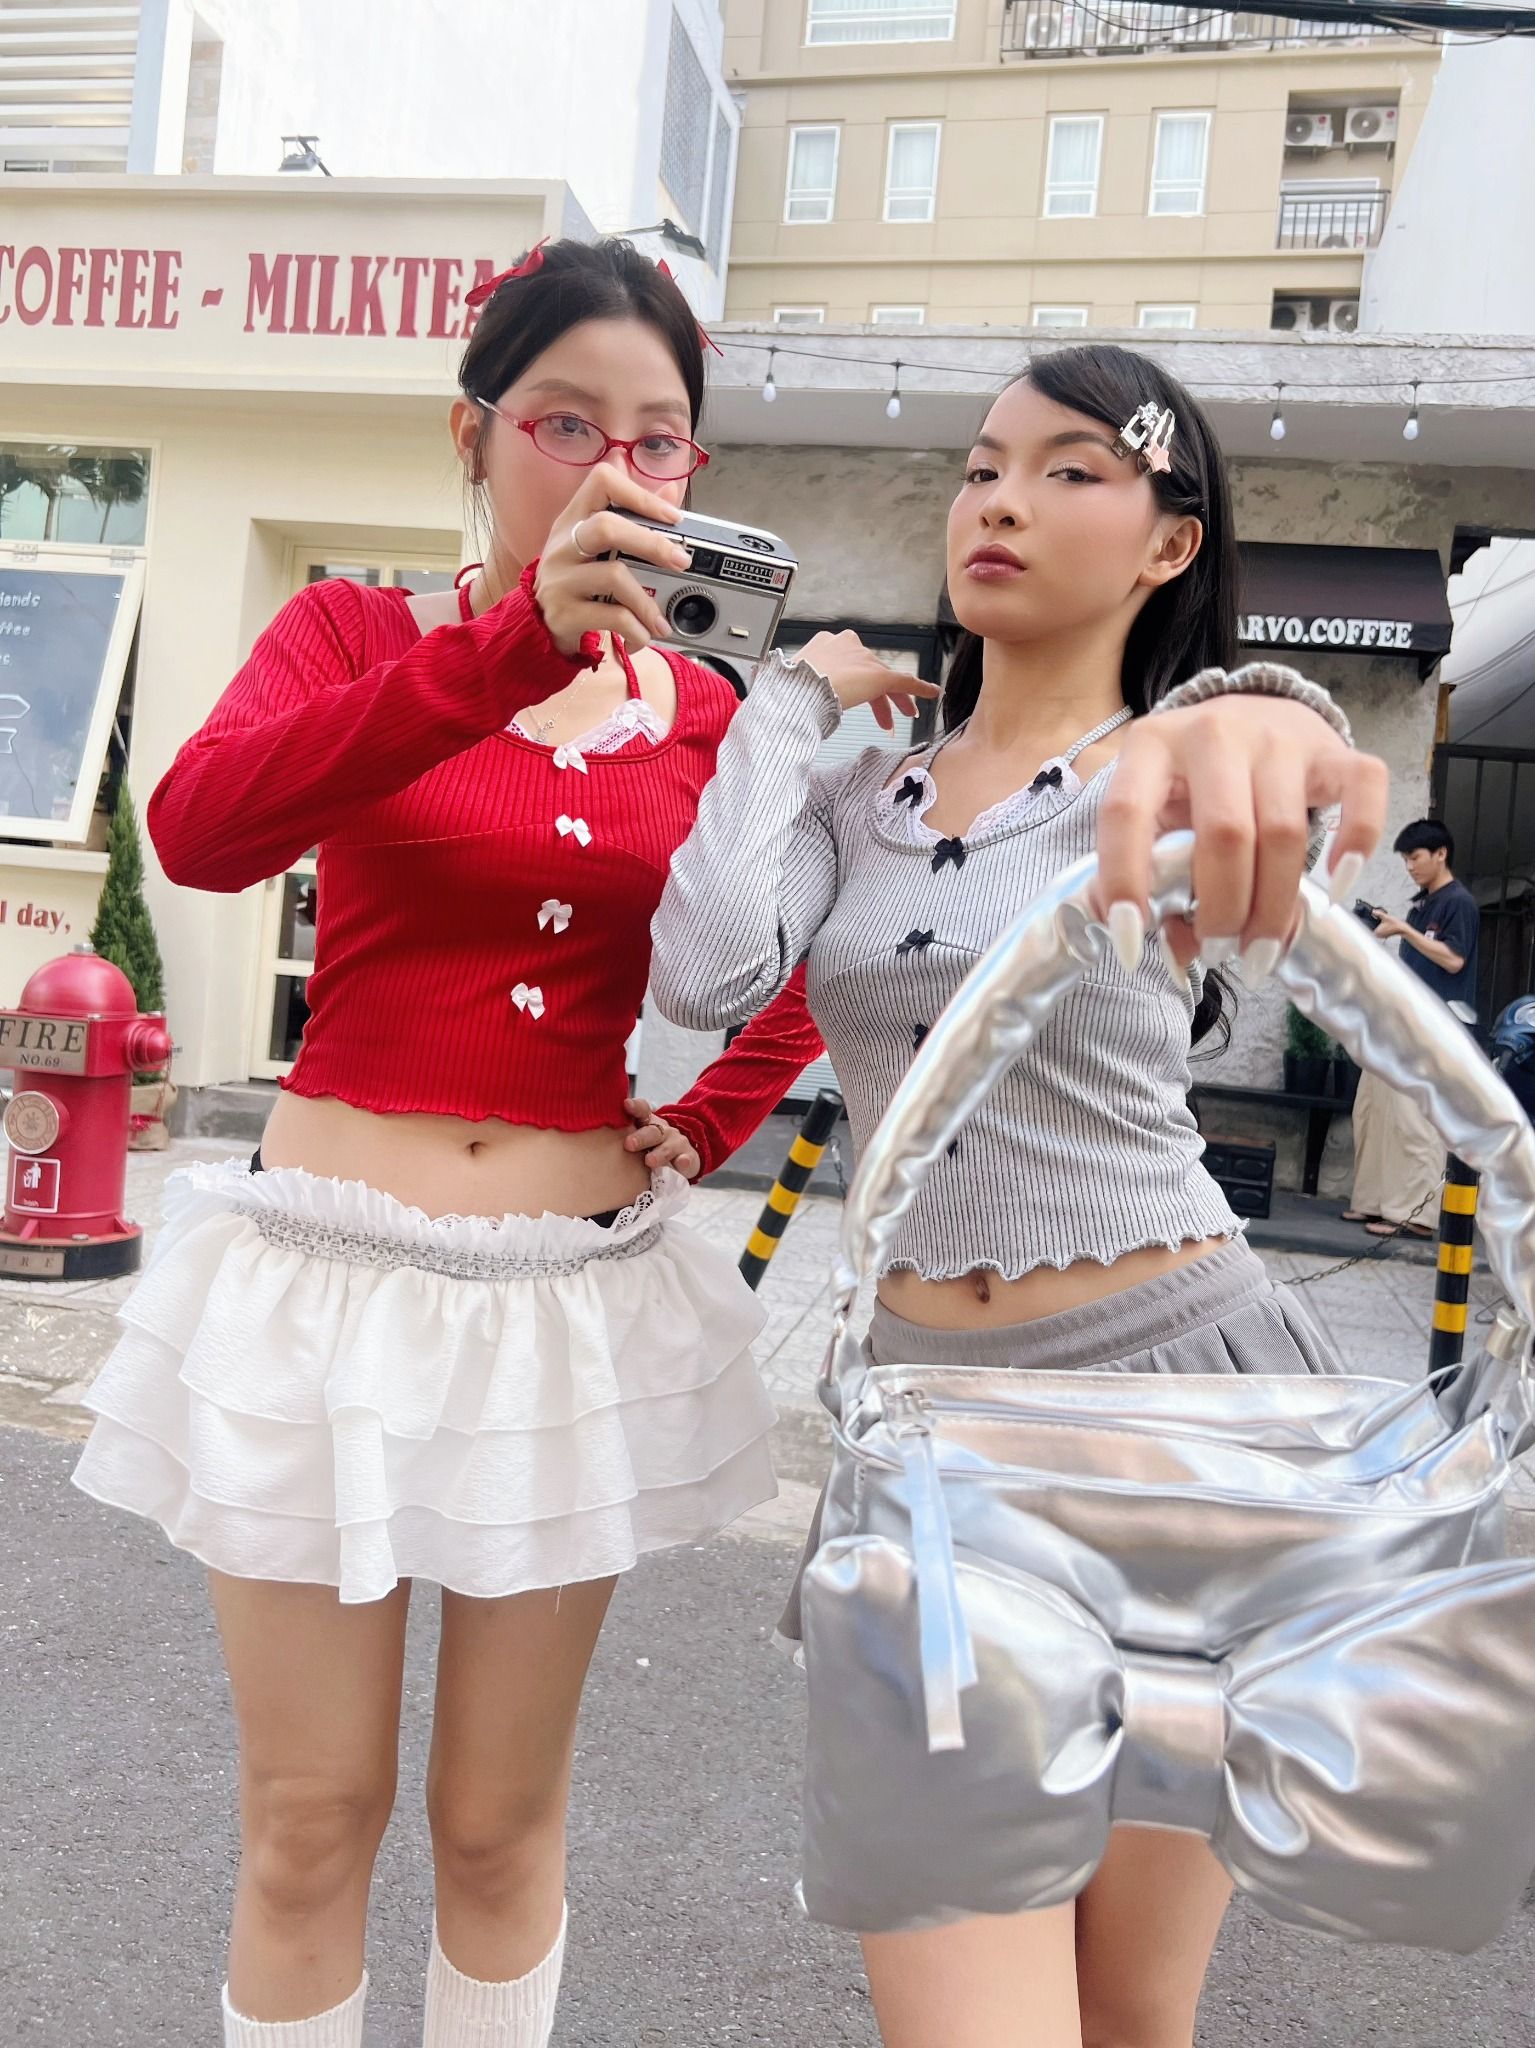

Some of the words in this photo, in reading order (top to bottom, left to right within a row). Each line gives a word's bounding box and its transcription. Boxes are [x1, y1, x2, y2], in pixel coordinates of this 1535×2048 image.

[0, 245, 183, 330] COFFEE
[17, 903, 71, 935] day,
[0, 1019, 85, 1053] FIRE
